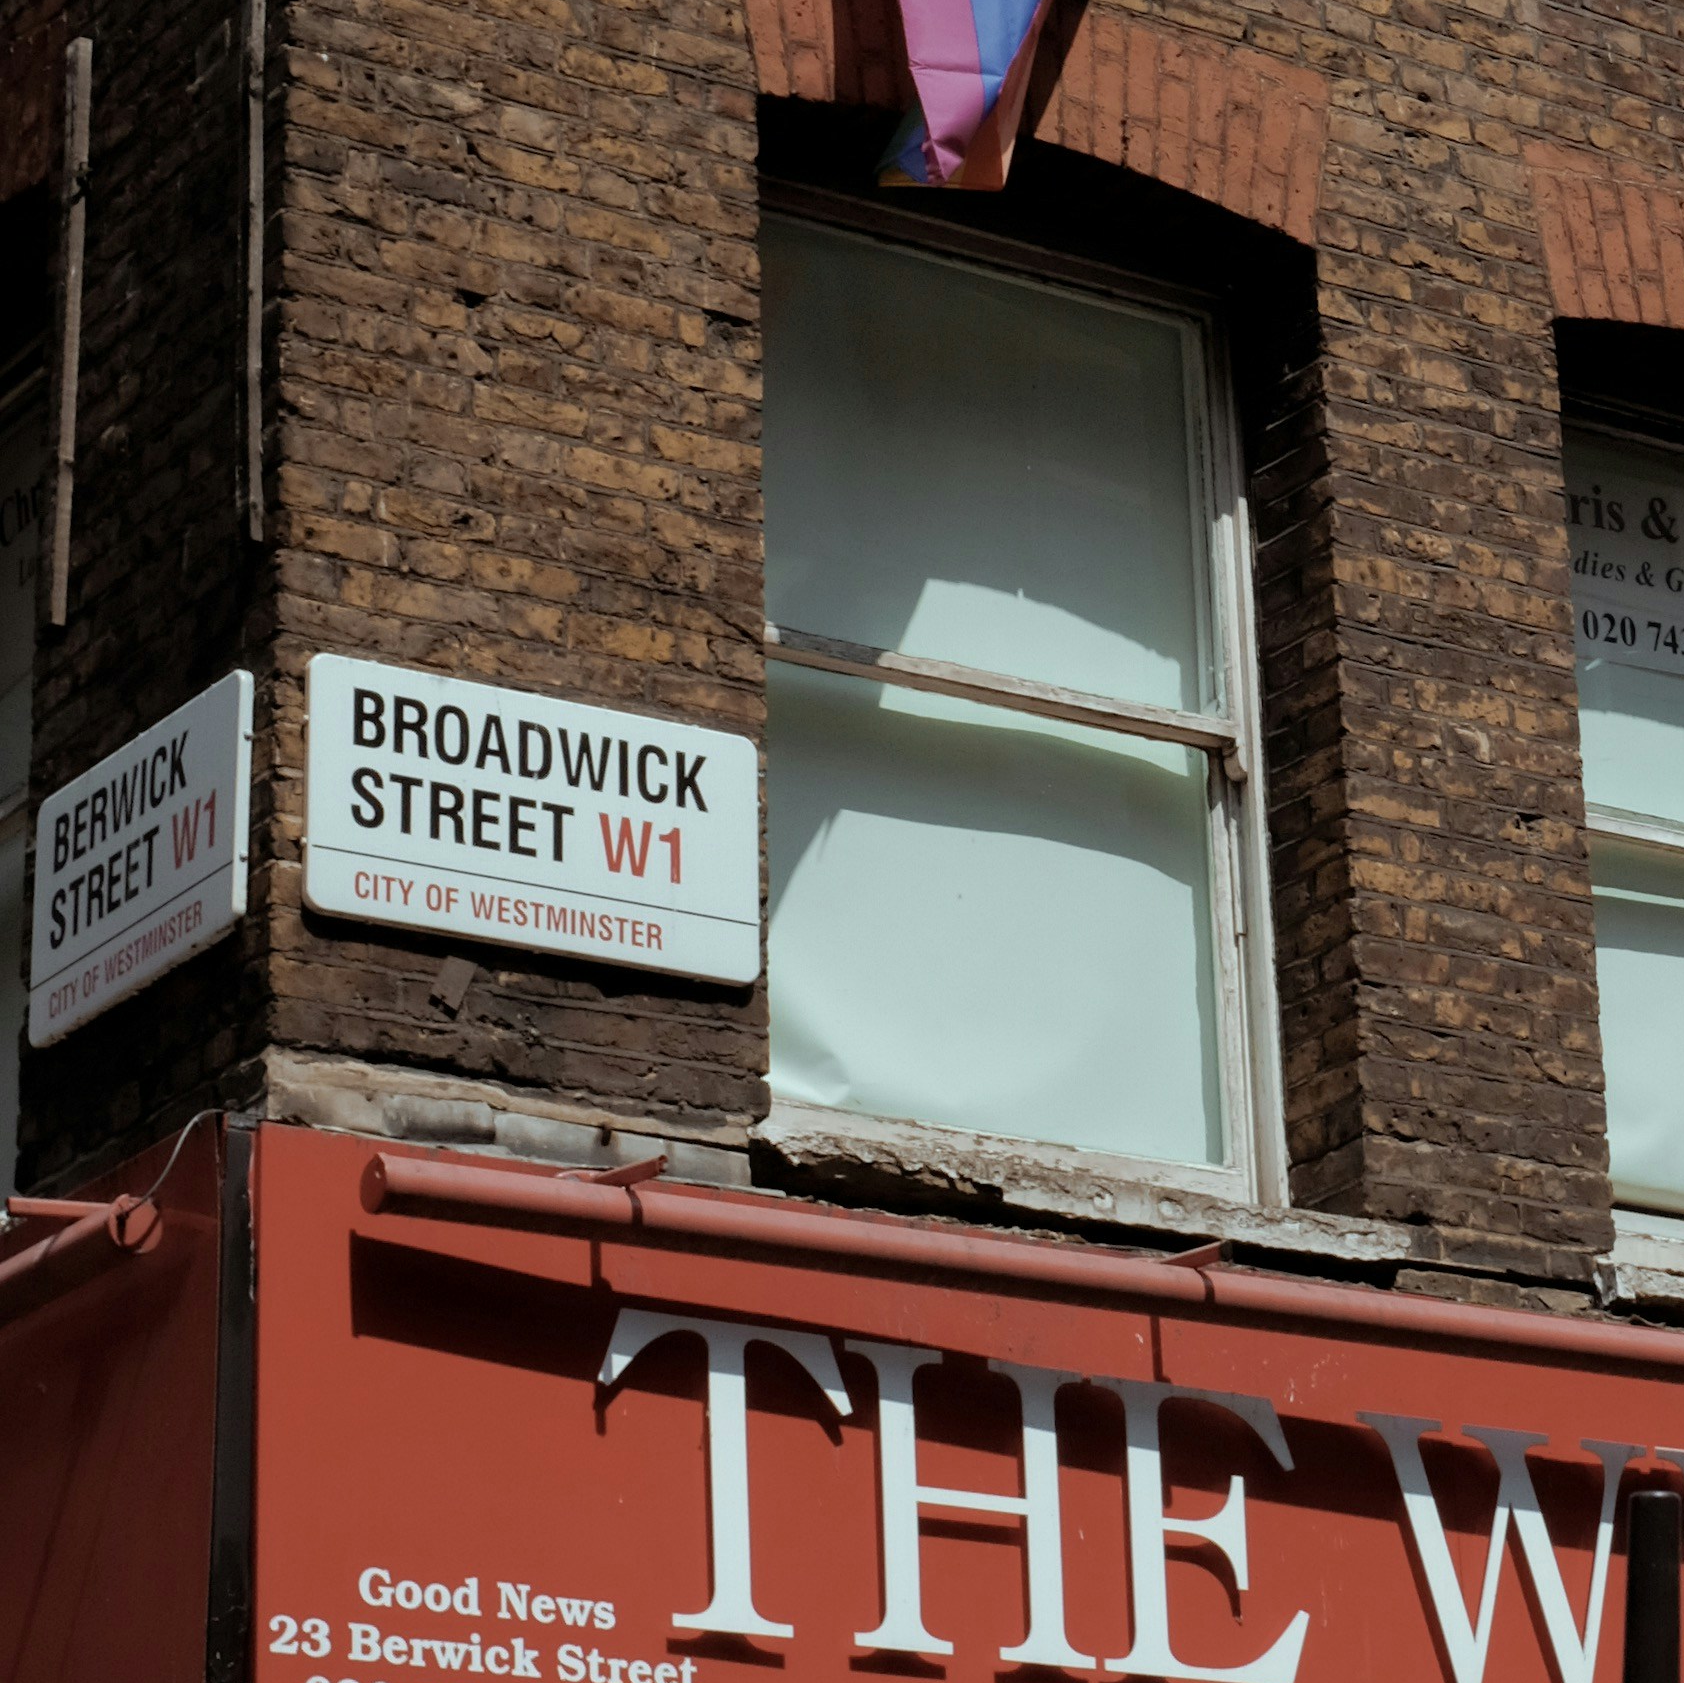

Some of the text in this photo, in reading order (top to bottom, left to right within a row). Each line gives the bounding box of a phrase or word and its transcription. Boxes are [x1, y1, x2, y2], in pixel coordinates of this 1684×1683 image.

[1640, 496, 1679, 544] &
[1635, 560, 1655, 587] &
[1582, 608, 1637, 648] 020
[352, 687, 709, 813] BROADWICK
[53, 730, 189, 874] BERWICK
[351, 767, 684, 885] STREET W1
[50, 788, 217, 950] STREET W1
[354, 870, 664, 952] CITY OF WESTMINSTER
[49, 900, 203, 1018] CITY OF WESTMINSTER
[358, 1566, 617, 1631] Good News
[268, 1614, 332, 1658] 23
[347, 1622, 542, 1679] Berwick
